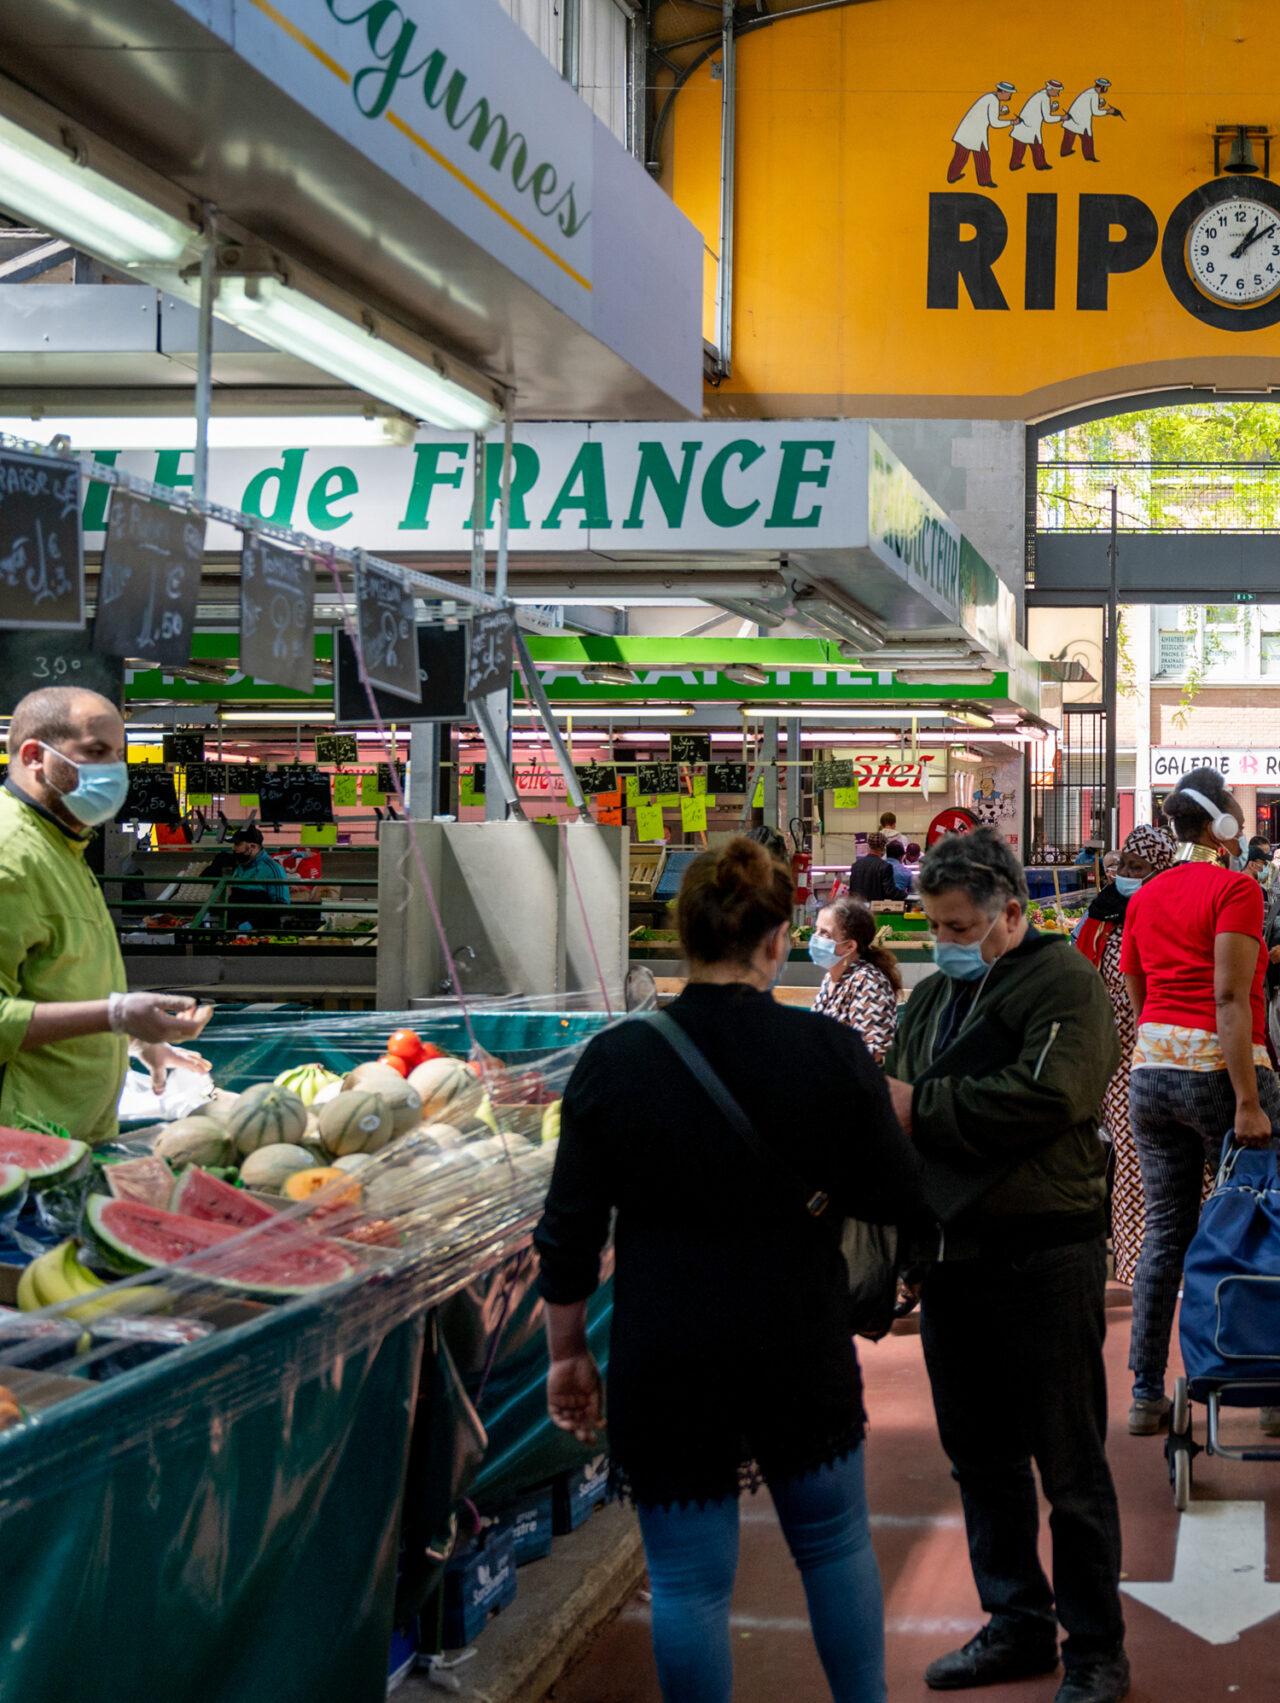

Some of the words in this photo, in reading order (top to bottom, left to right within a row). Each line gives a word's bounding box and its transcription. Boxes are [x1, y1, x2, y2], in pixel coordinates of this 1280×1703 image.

[1218, 216, 1228, 227] 11
[1234, 211, 1247, 223] 12
[1205, 227, 1217, 239] 10
[1200, 245, 1210, 256] 9
[1271, 245, 1280, 256] 3
[1206, 261, 1215, 273] 8
[1265, 262, 1275, 274] 4
[1219, 273, 1229, 286] 7
[1235, 278, 1245, 290] 6
[1253, 274, 1263, 286] 5
[241, 447, 359, 531] de
[398, 439, 835, 531] FRANCE
